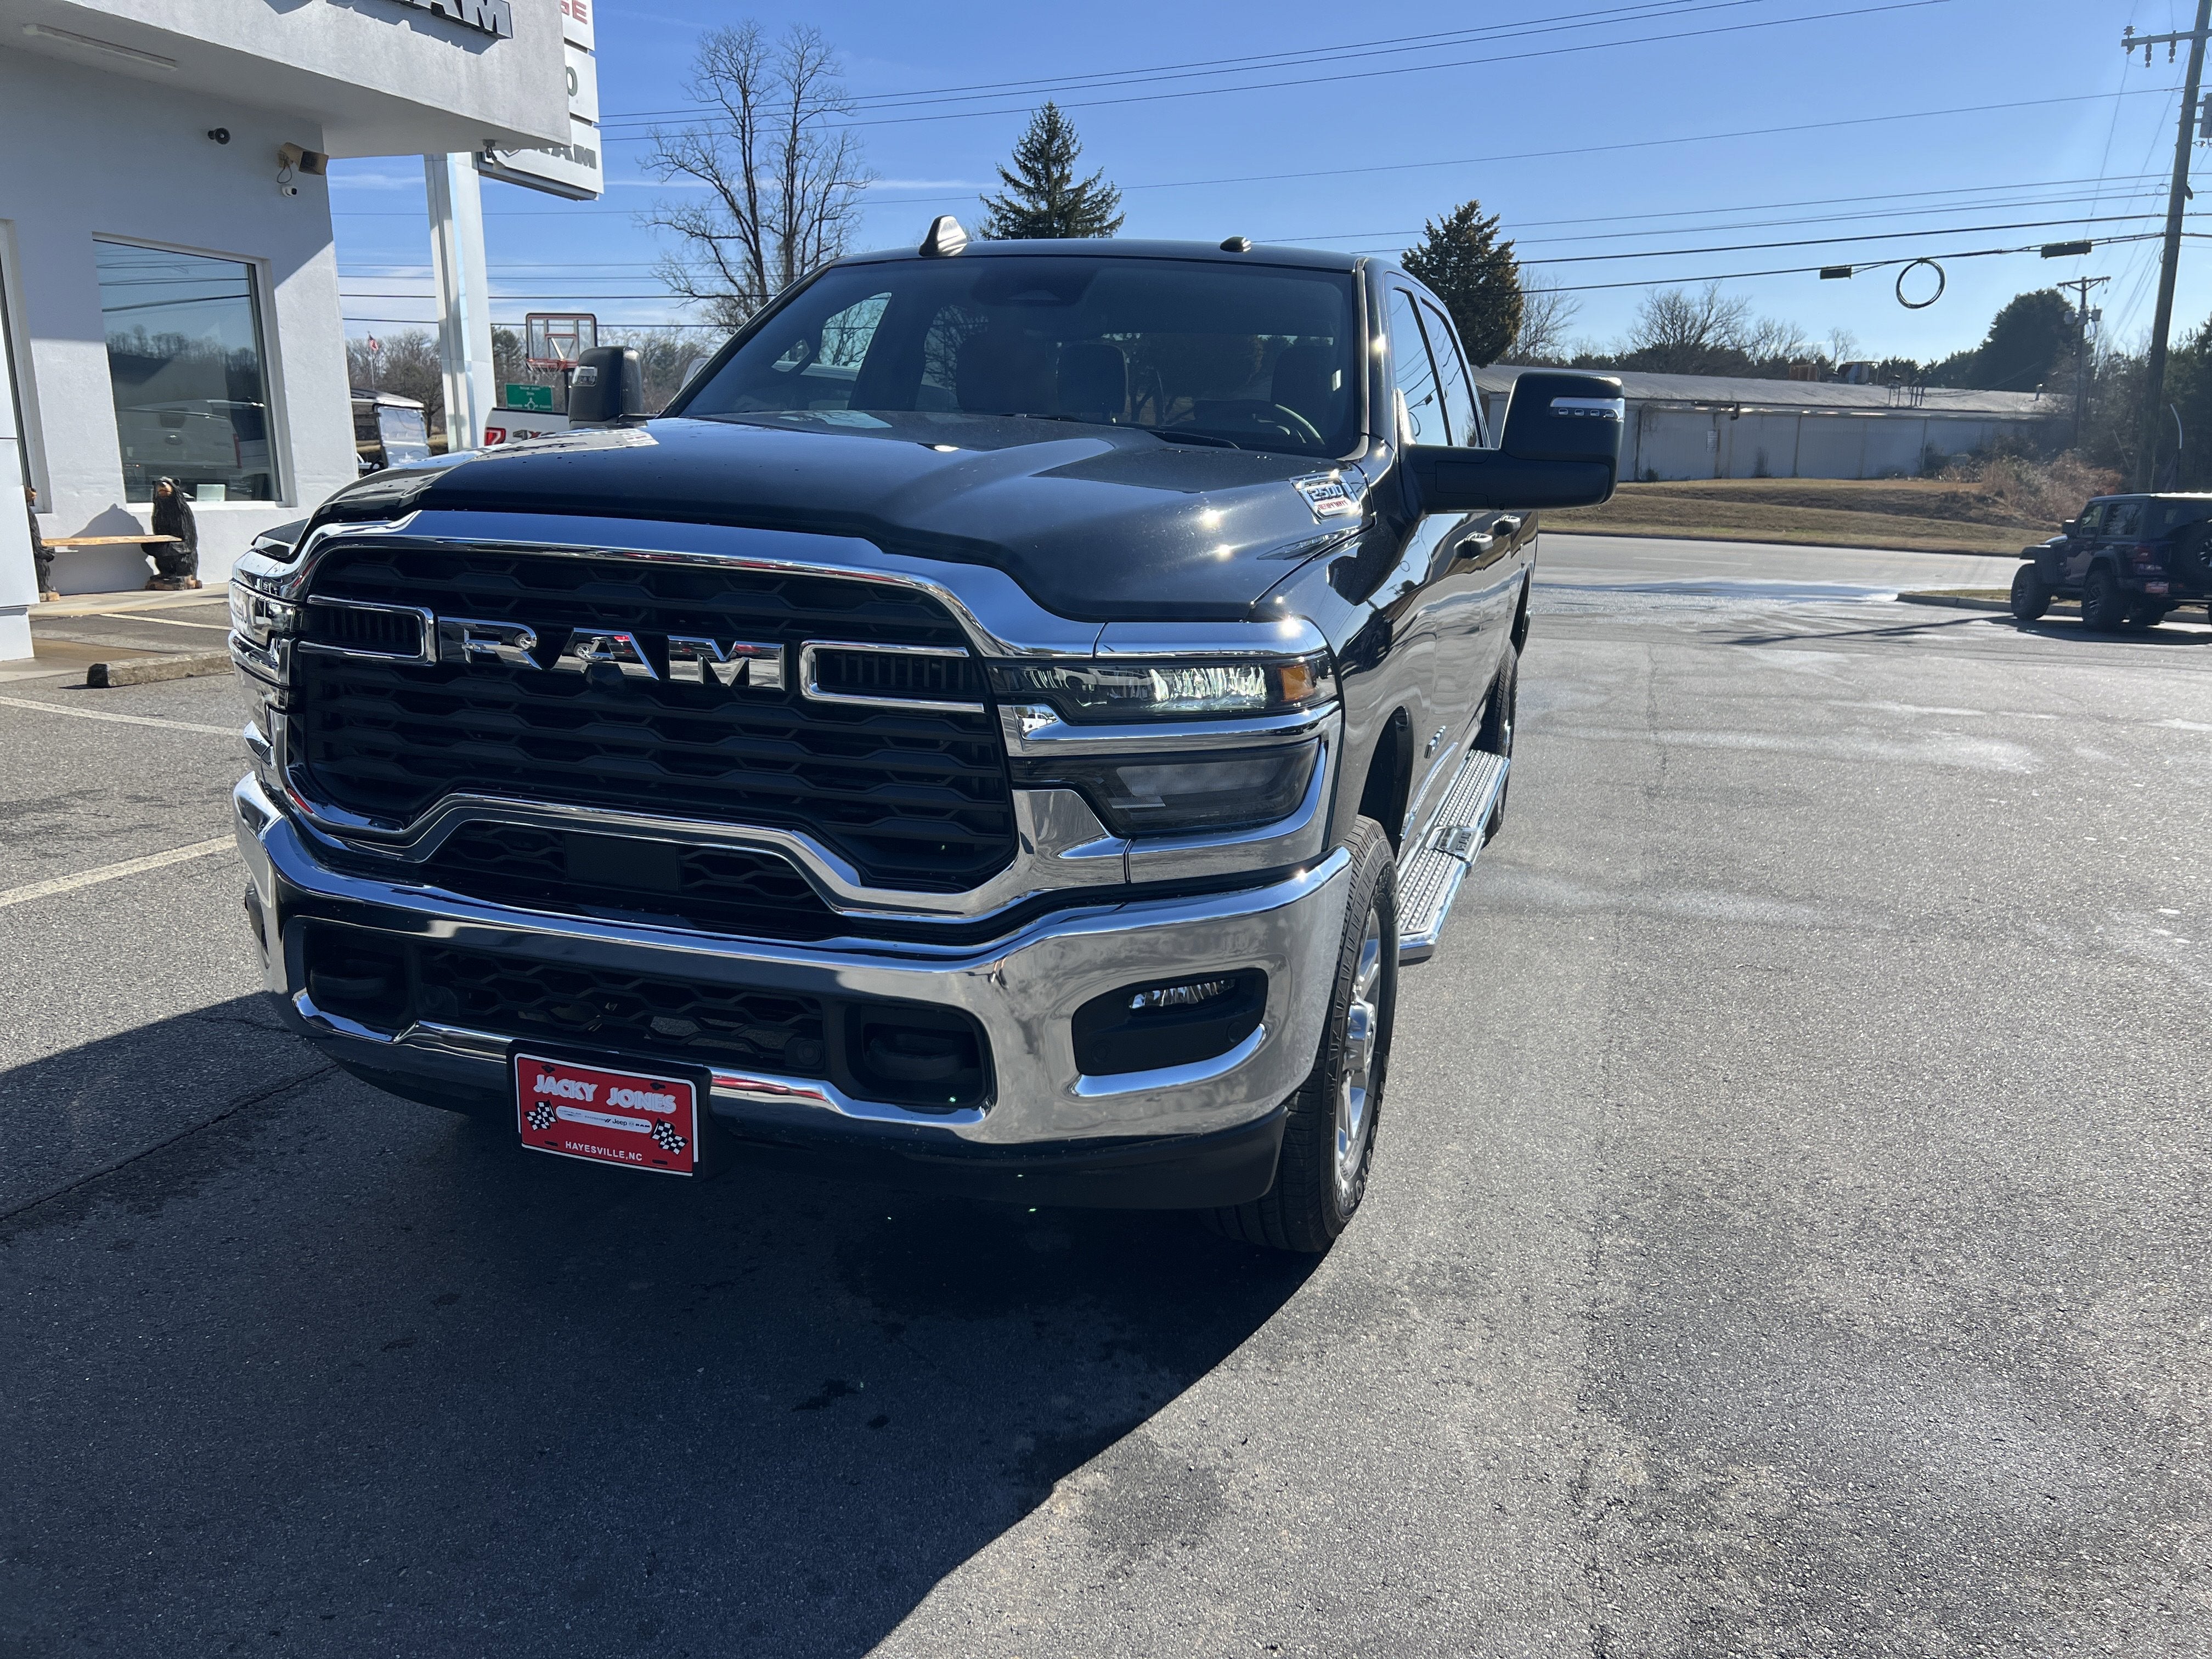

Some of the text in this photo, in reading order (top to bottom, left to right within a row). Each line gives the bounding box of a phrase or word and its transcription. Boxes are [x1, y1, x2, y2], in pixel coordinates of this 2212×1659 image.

[538, 143, 597, 170] AM
[1311, 484, 1344, 500] 2500
[438, 616, 786, 692] RAM
[533, 1074, 677, 1114] JACKY JONES
[612, 1118, 628, 1127] Jeep
